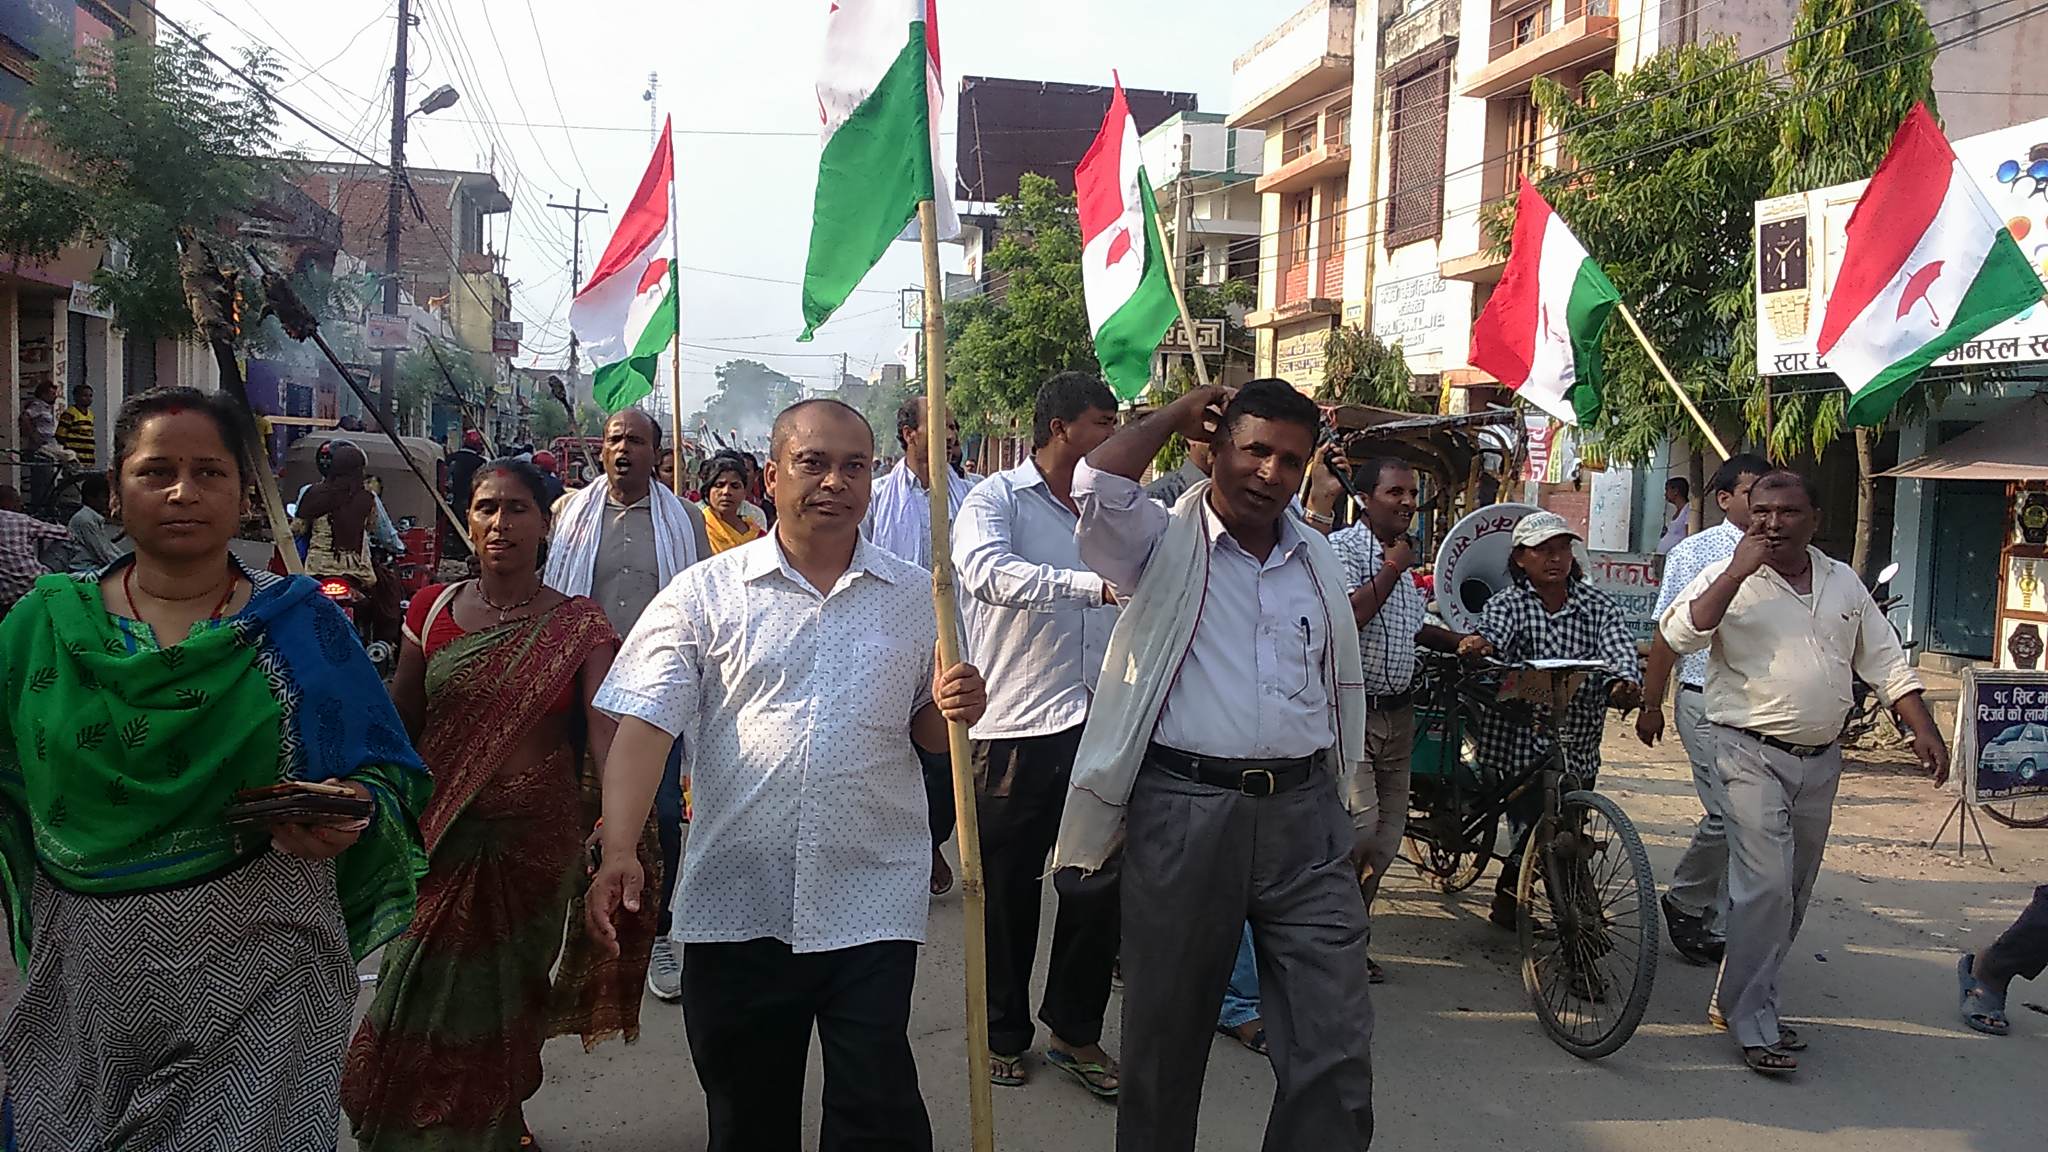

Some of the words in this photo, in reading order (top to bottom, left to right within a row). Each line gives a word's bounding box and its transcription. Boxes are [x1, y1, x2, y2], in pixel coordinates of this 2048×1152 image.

[1774, 352, 1810, 372] स्टार
[1993, 690, 2010, 705] १८
[2012, 687, 2037, 705] सिट
[1977, 704, 2006, 721] रिजर्व
[2007, 704, 2022, 721] को
